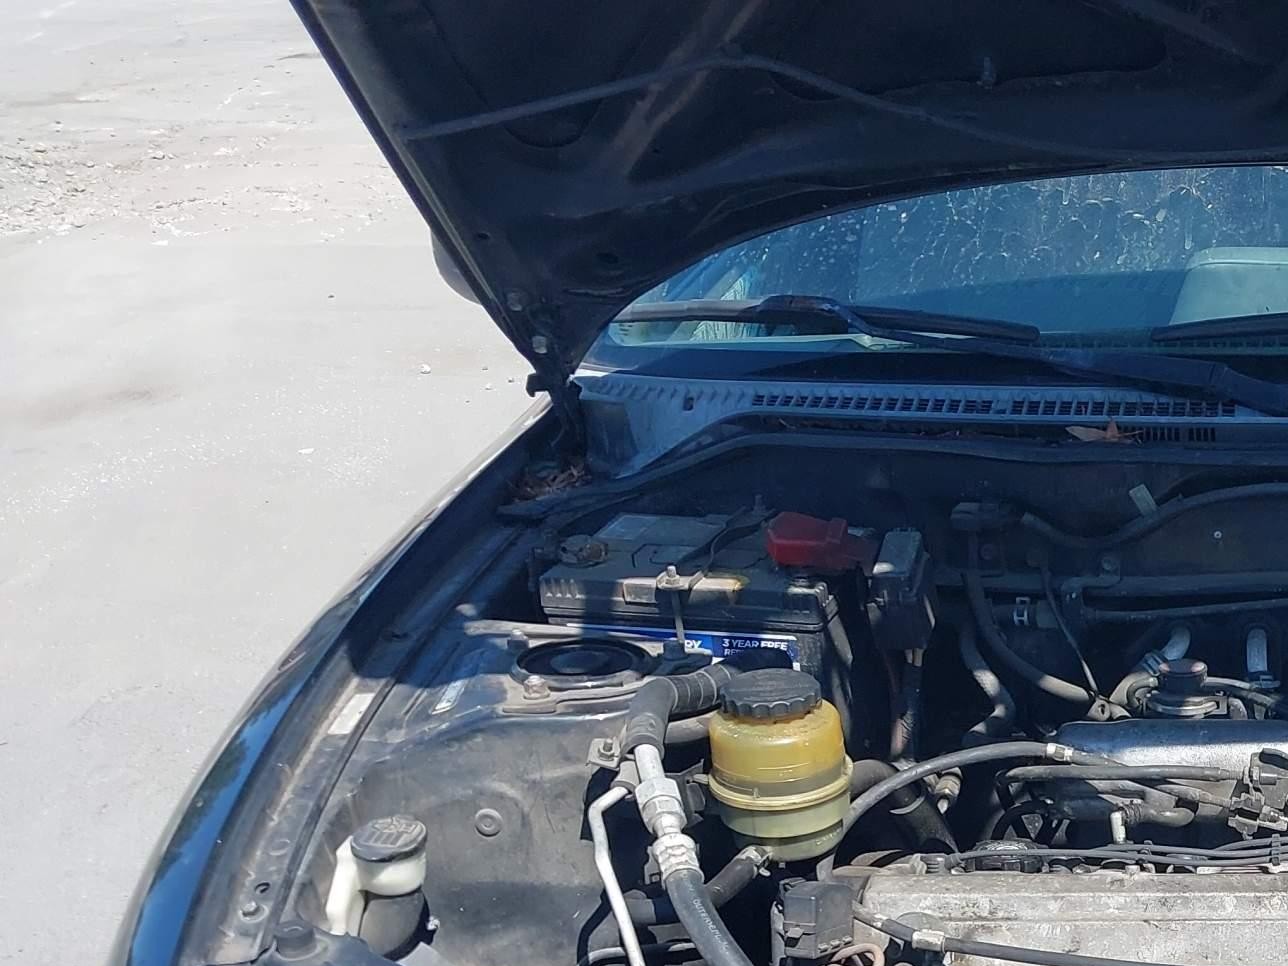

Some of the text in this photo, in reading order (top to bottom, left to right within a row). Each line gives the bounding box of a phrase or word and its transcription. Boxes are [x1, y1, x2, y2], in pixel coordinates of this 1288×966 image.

[722, 639, 729, 647] 3
[732, 640, 760, 648] YEAR
[761, 641, 789, 651] FREE
